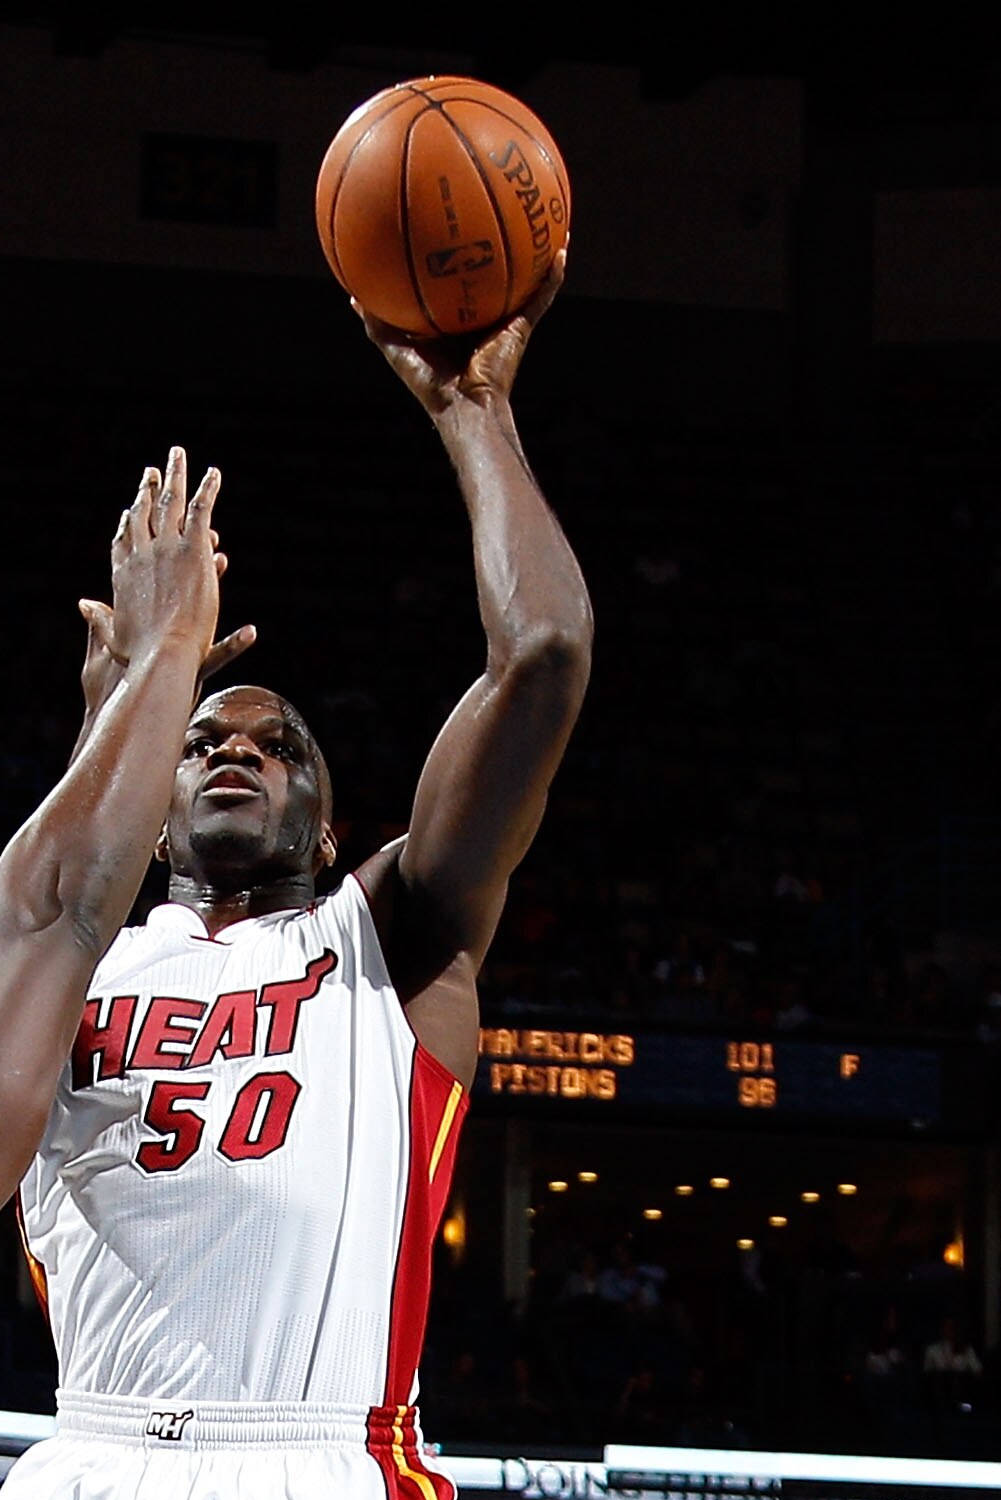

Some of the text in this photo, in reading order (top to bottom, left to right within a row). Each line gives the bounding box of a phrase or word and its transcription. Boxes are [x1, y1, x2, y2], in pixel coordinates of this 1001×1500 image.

[71, 948, 338, 1092] HEAT
[478, 1026, 775, 1073] MAVERICKS 101
[840, 1052, 861, 1080] F
[490, 1062, 618, 1101] PISTONS
[133, 1070, 300, 1175] 50
